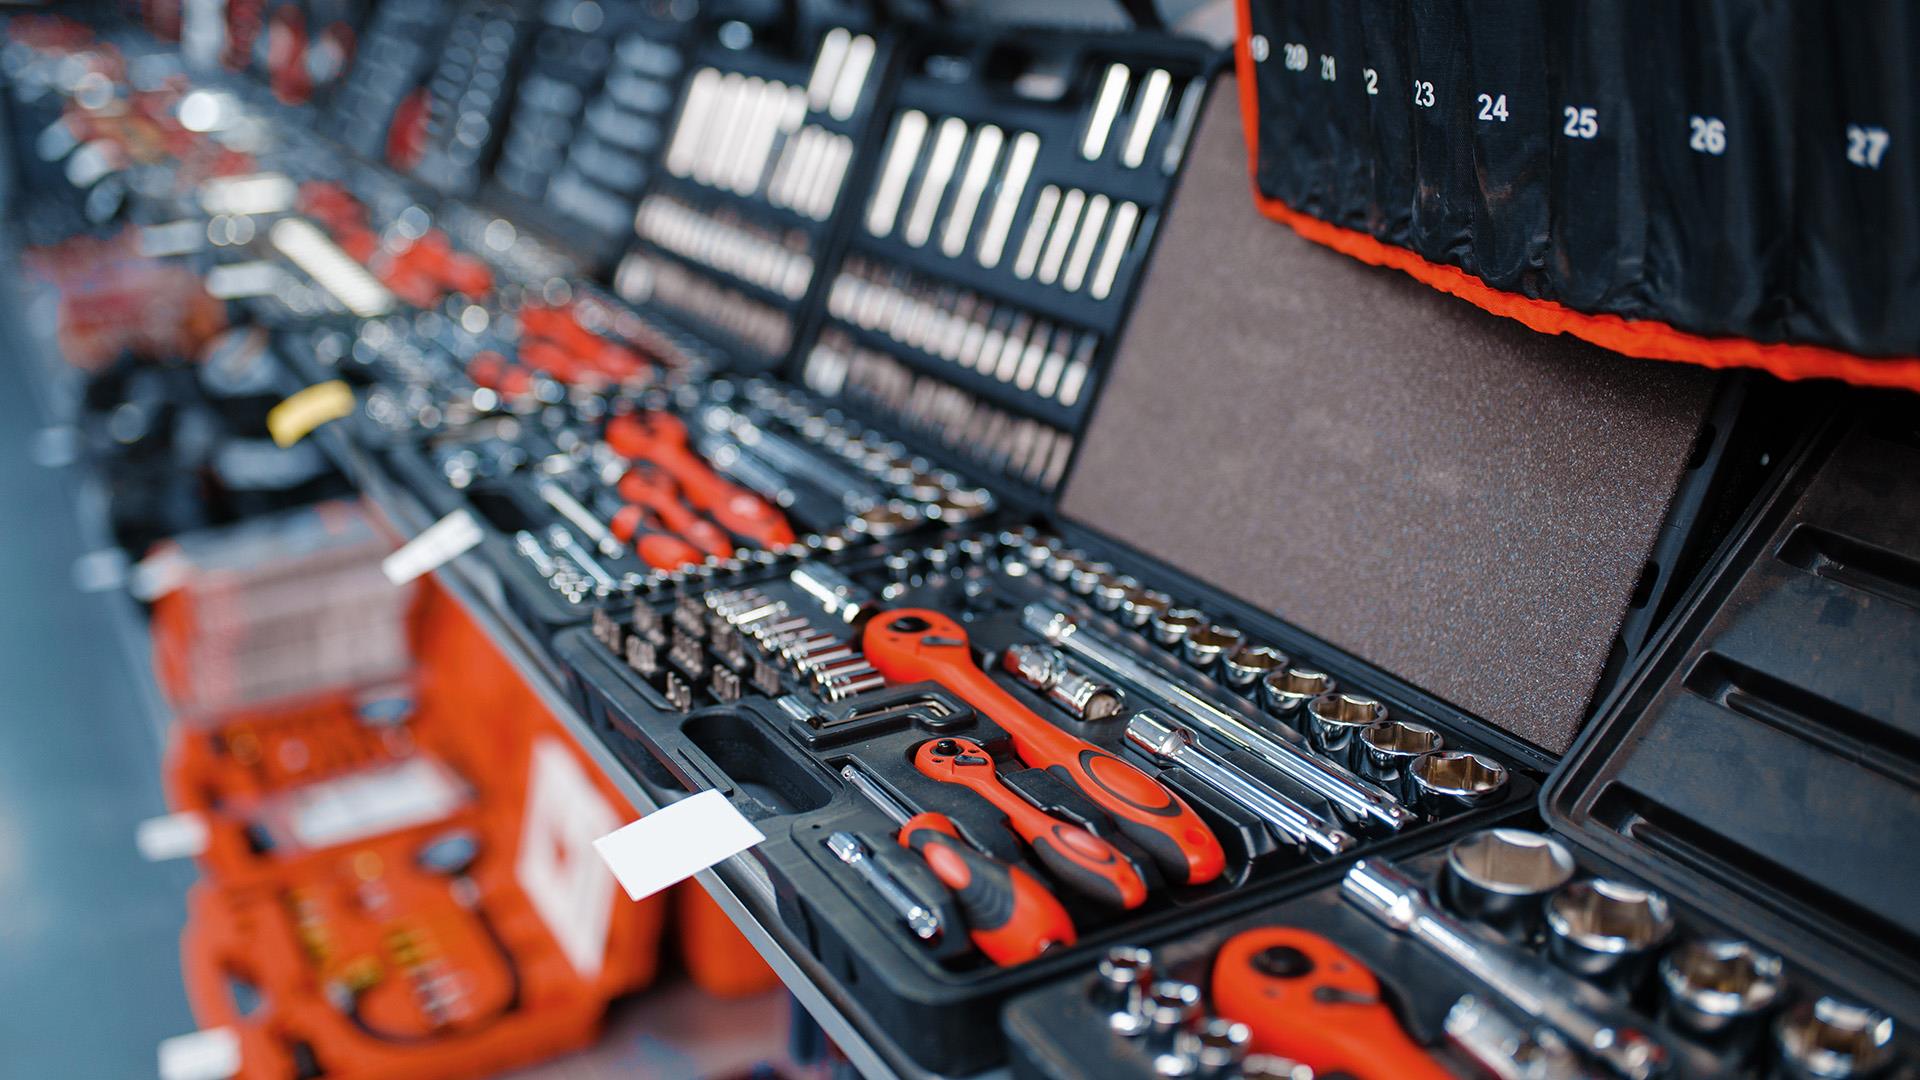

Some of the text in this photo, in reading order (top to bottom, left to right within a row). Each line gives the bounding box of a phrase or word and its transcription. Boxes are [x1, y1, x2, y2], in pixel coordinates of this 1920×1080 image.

[1248, 34, 1889, 168] 9 20 21 2 23 24 25 26 27
